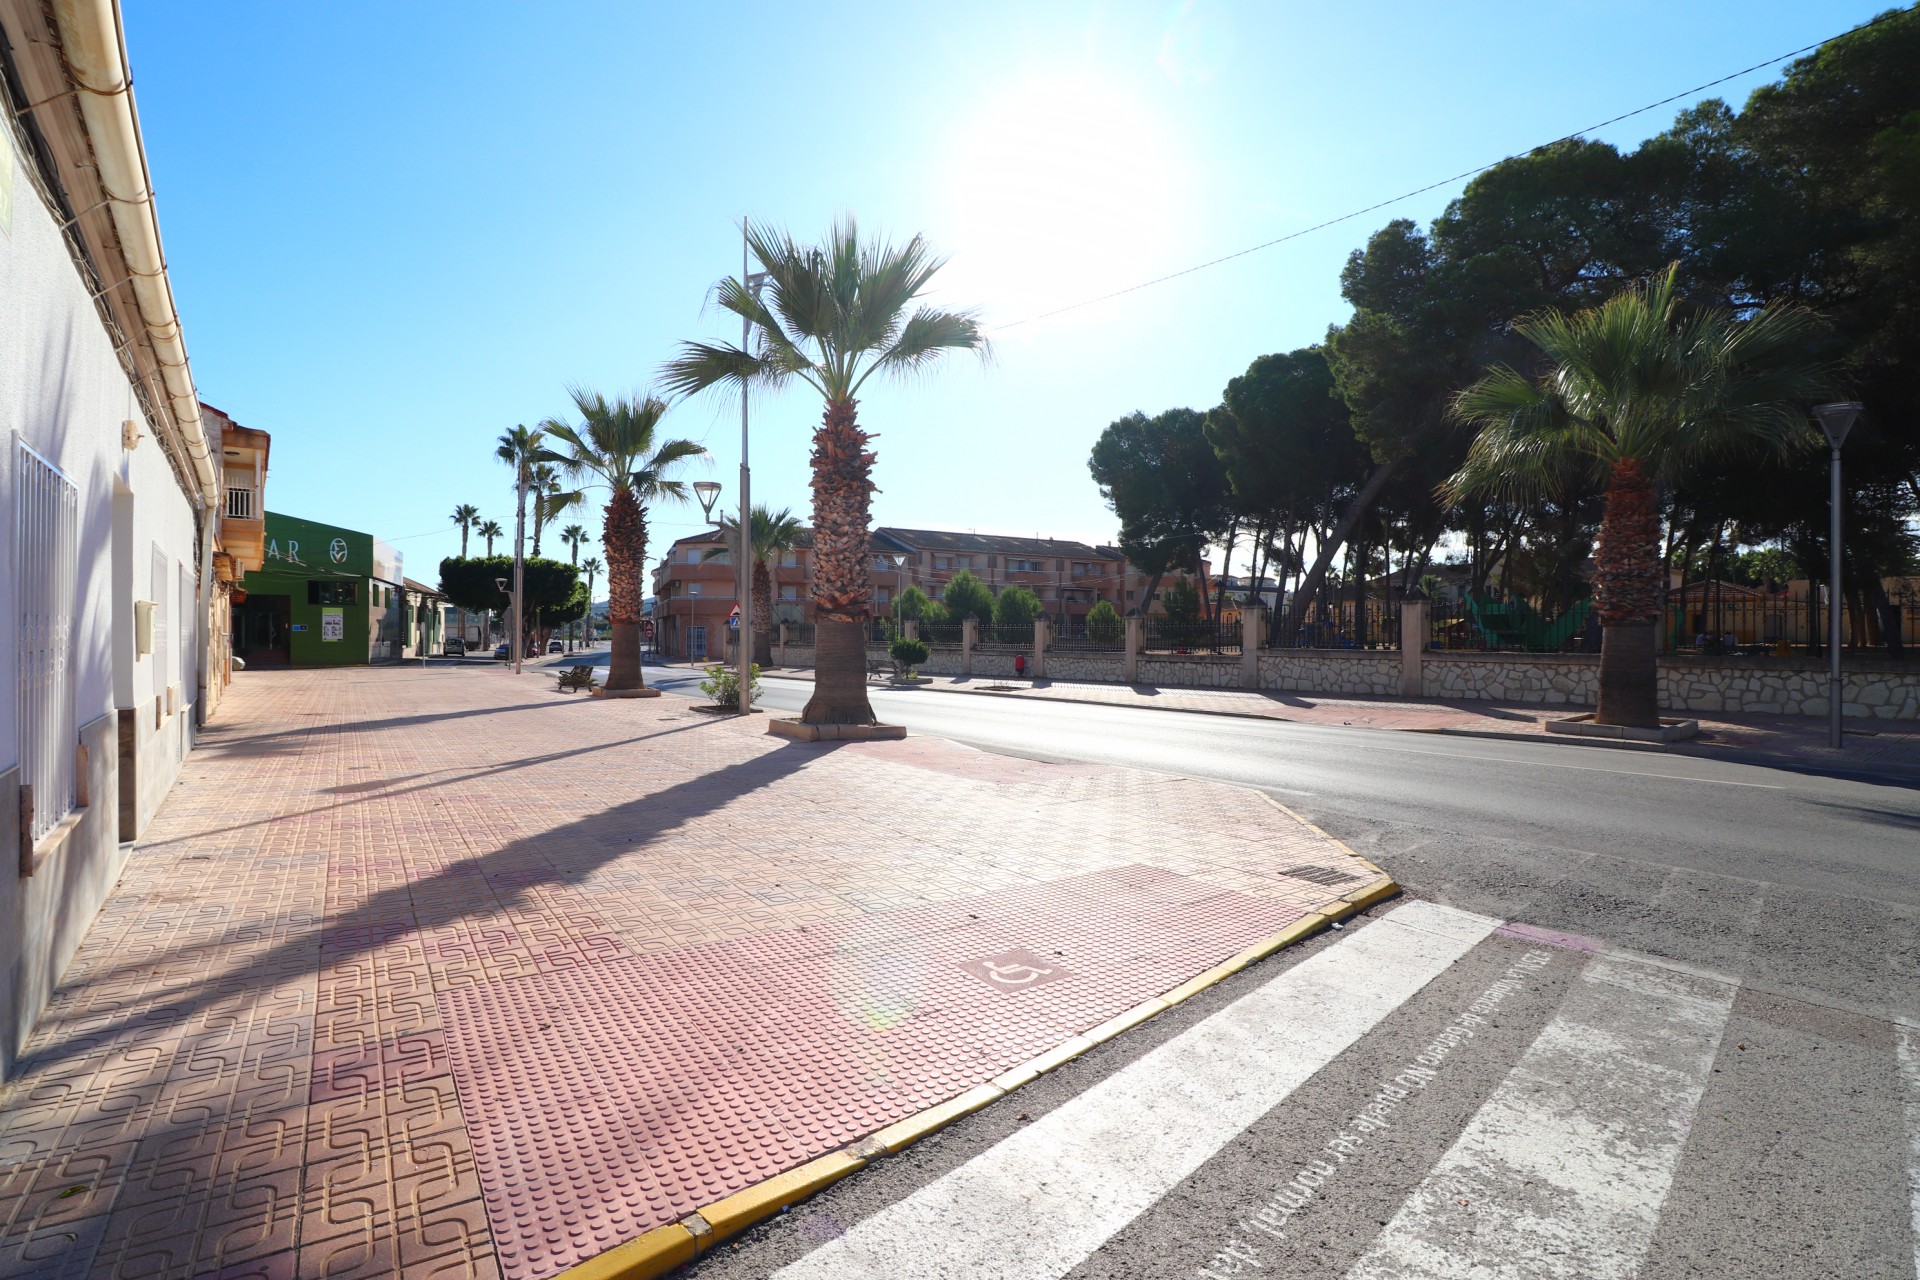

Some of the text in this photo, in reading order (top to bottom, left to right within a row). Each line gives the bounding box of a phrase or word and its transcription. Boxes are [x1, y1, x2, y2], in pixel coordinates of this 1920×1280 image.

[1505, 968, 1532, 978] La
[1454, 1012, 1488, 1027] de
[1323, 1131, 1363, 1163] ser
